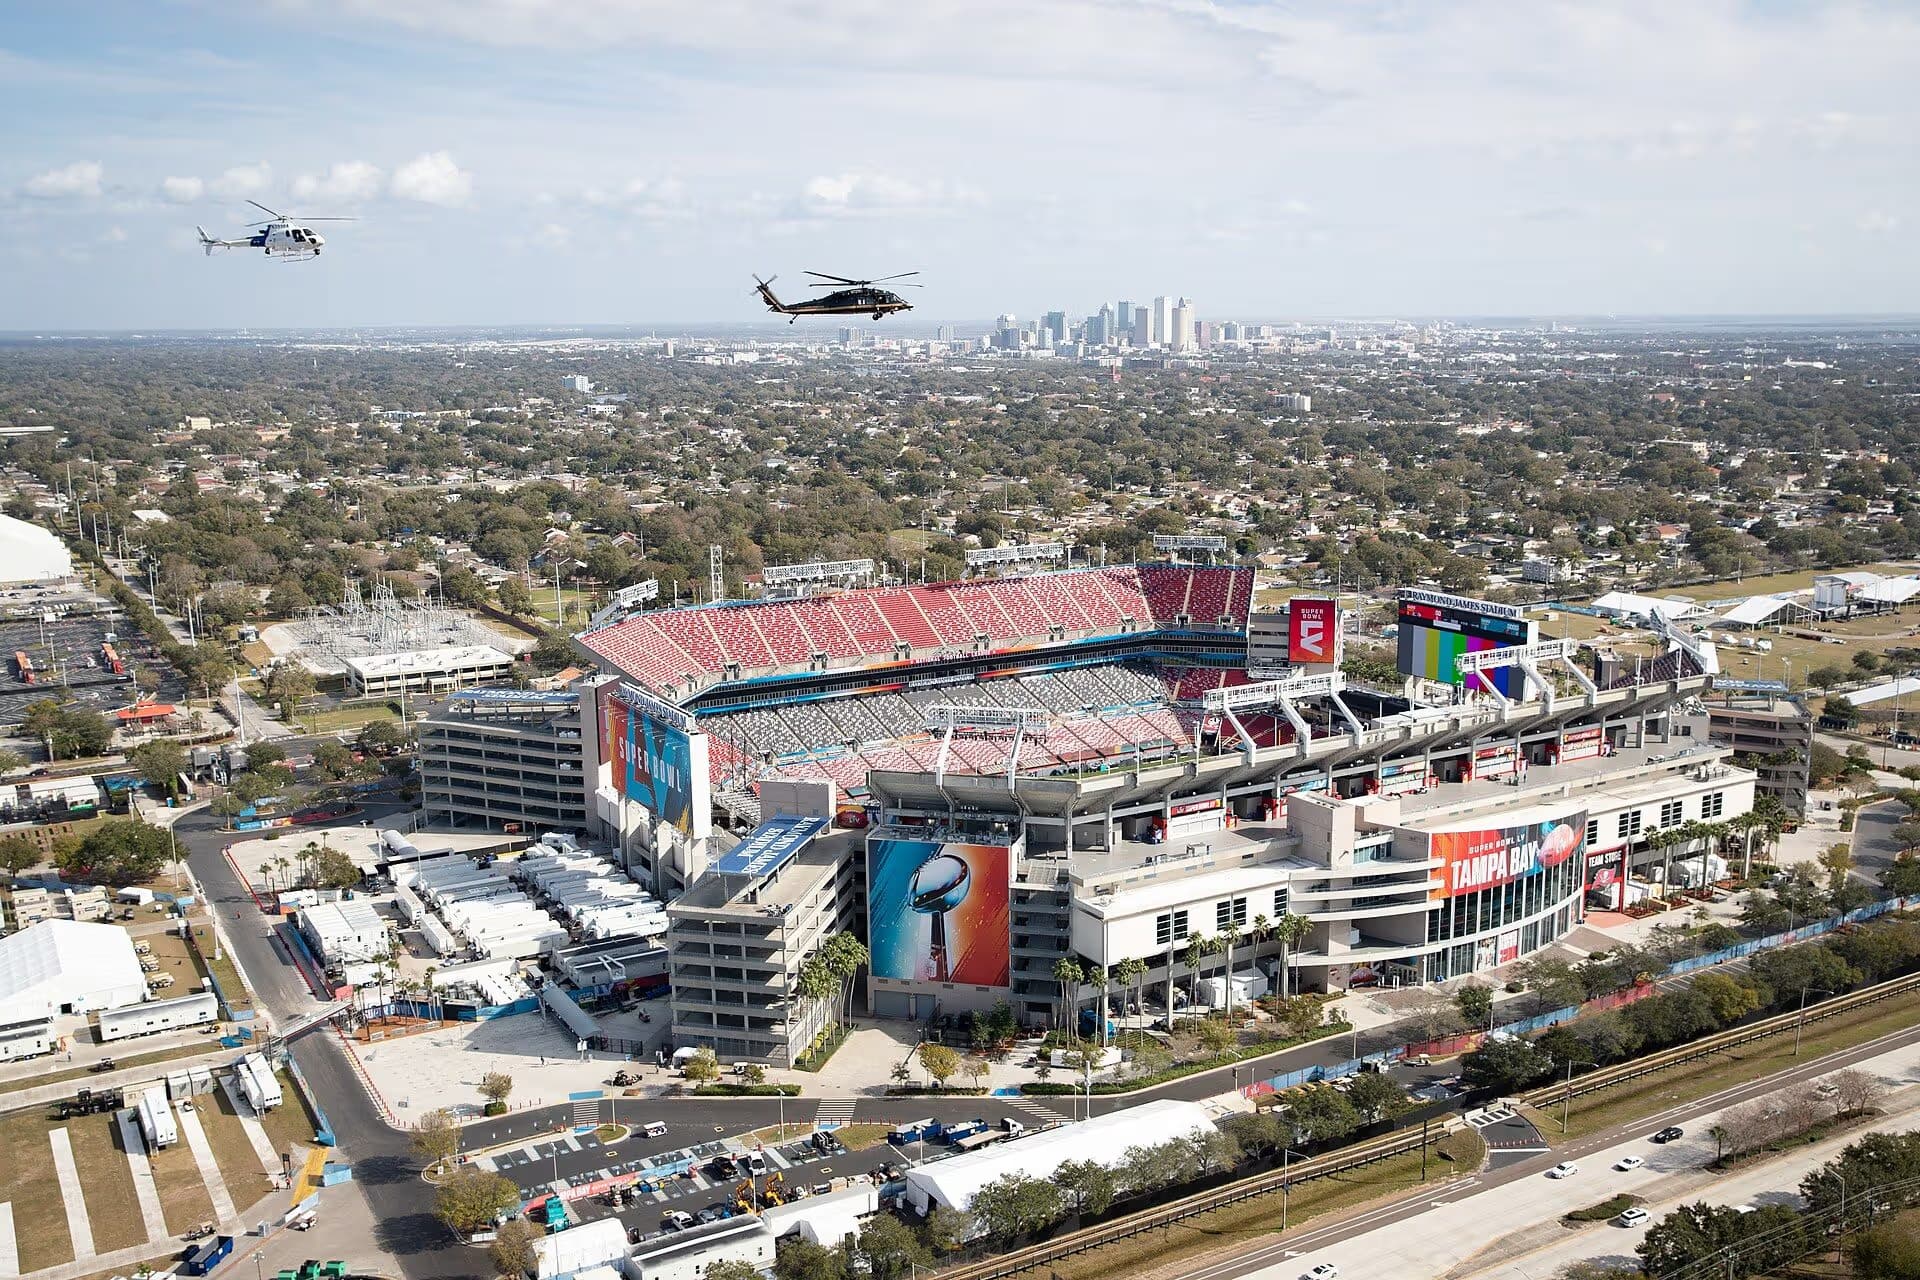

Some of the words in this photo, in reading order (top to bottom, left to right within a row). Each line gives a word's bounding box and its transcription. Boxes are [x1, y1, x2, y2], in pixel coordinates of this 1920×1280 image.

[1412, 592, 1452, 606] RAYMOND
[1453, 599, 1480, 611] JAMES
[1481, 602, 1517, 617] STADIUM
[1300, 620, 1323, 656] LV
[619, 736, 649, 774] SUPER
[653, 755, 682, 793] BOWL
[1469, 842, 1495, 854] SUPER
[1495, 837, 1516, 849] BOWL
[1517, 833, 1525, 843] LV
[1588, 854, 1604, 868] TEAM
[1604, 849, 1622, 864] STORE
[1451, 850, 1508, 890] TAMPA
[1509, 840, 1540, 876] BAY
